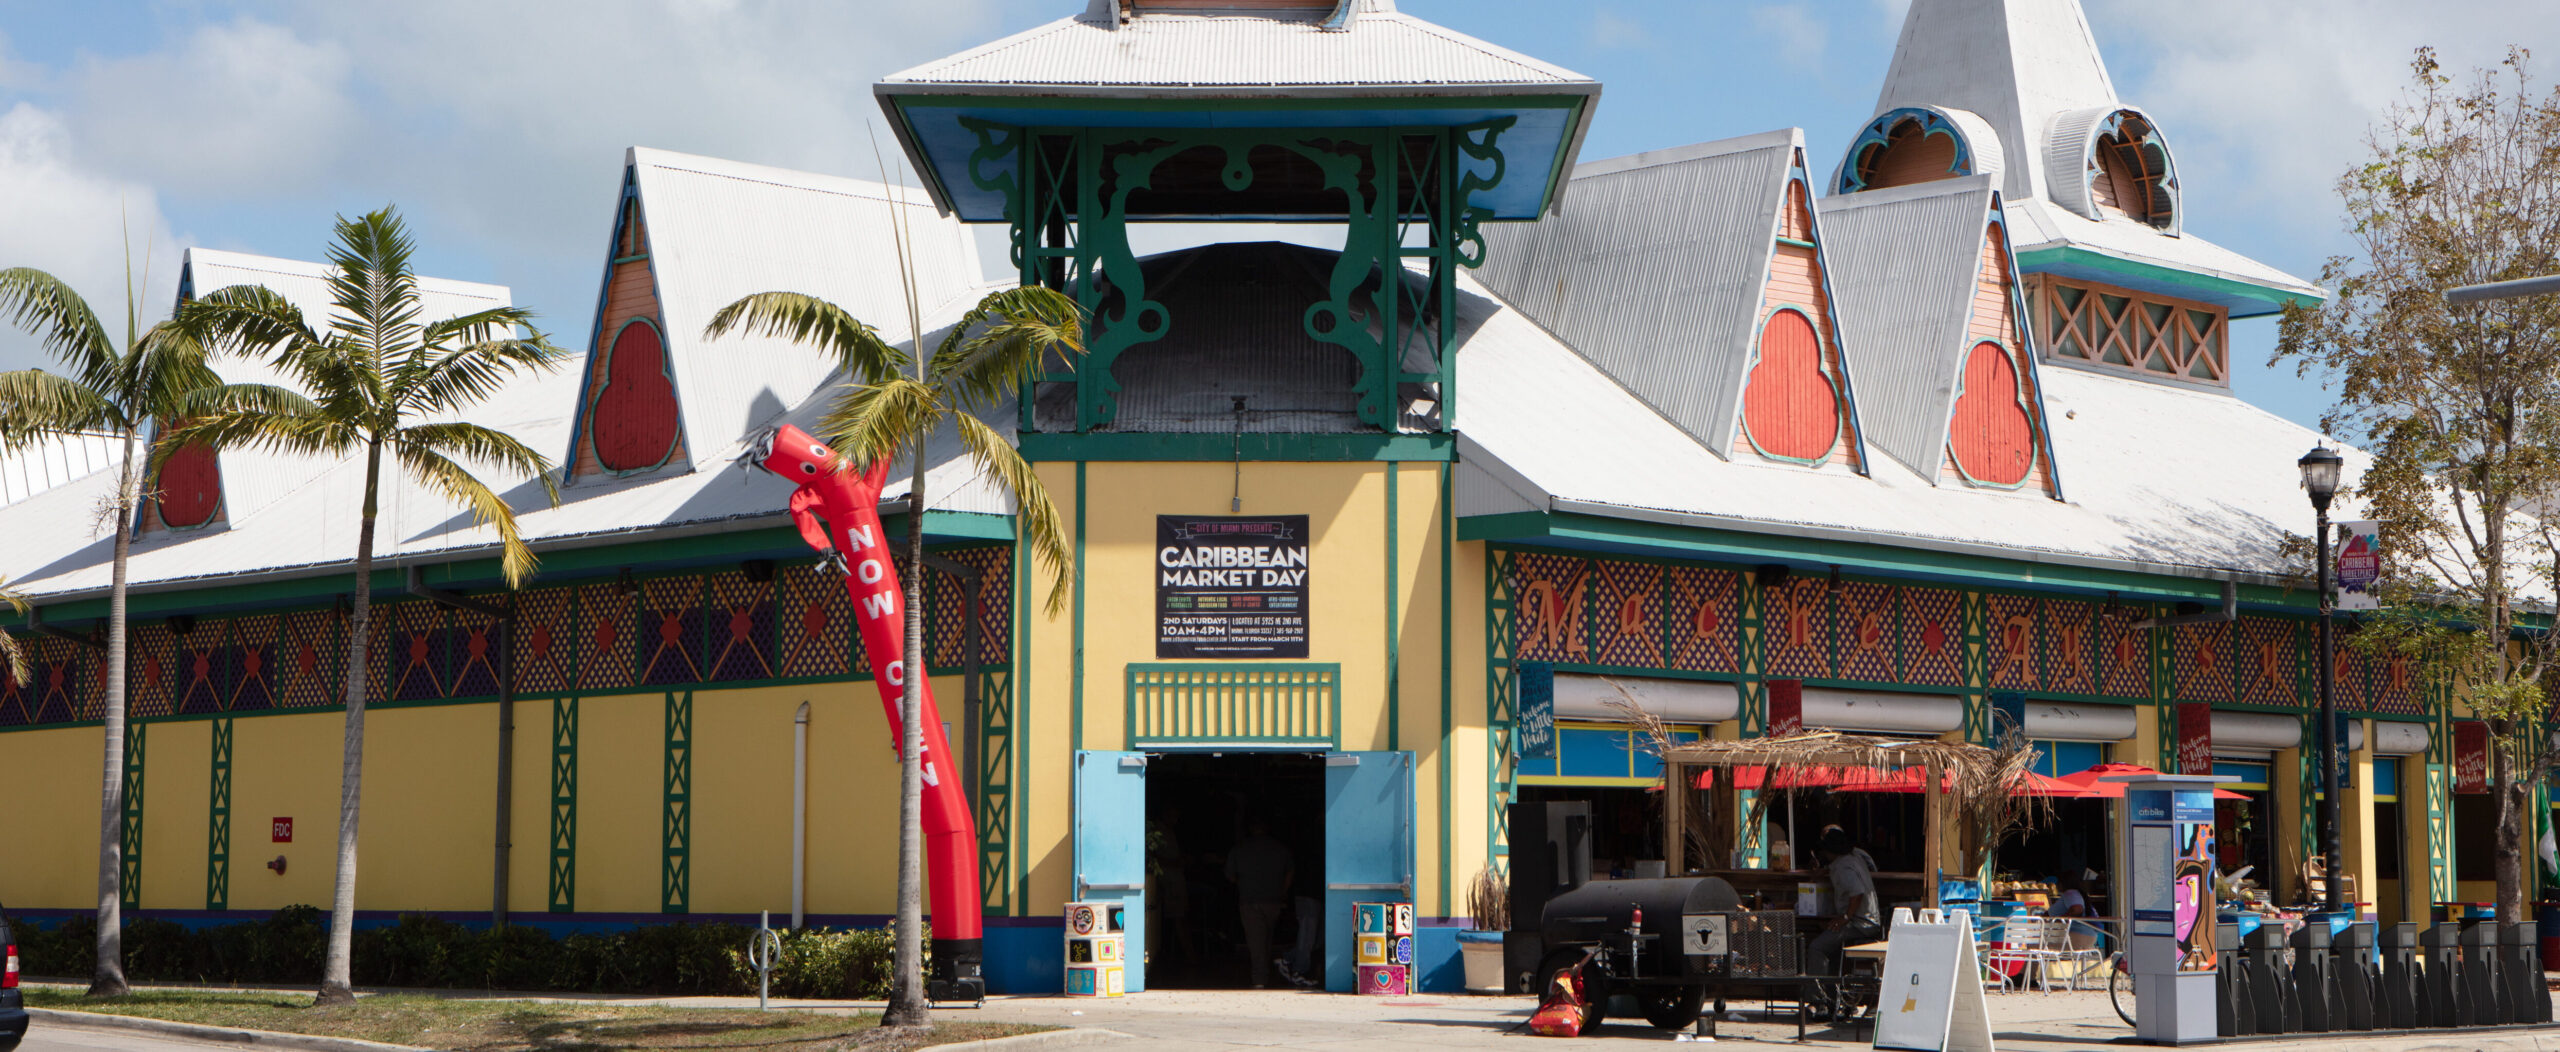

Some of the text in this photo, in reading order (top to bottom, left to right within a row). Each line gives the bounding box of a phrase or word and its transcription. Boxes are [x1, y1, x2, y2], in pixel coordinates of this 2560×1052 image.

[1196, 523, 1273, 533] CITY OF MIAMI PRESENTS
[1160, 546, 1307, 568] CARIBBEAN
[2341, 556, 2375, 569] CARIBBEAN
[848, 524, 894, 620] NOW
[1162, 569, 1306, 587] MARKET DAY
[2341, 568, 2375, 578] MARKETPLACE
[1521, 571, 1879, 653] Mache
[1163, 616, 1228, 625] 2ND SATURDAYS
[1232, 616, 1253, 626] LOCATED
[1254, 616, 1260, 626] AT
[1292, 616, 1302, 626] AVE
[1162, 626, 1226, 636] 10AM-4PM
[885, 659, 940, 790] ON
[1530, 711, 1553, 733] Little
[274, 823, 290, 837] FDC
